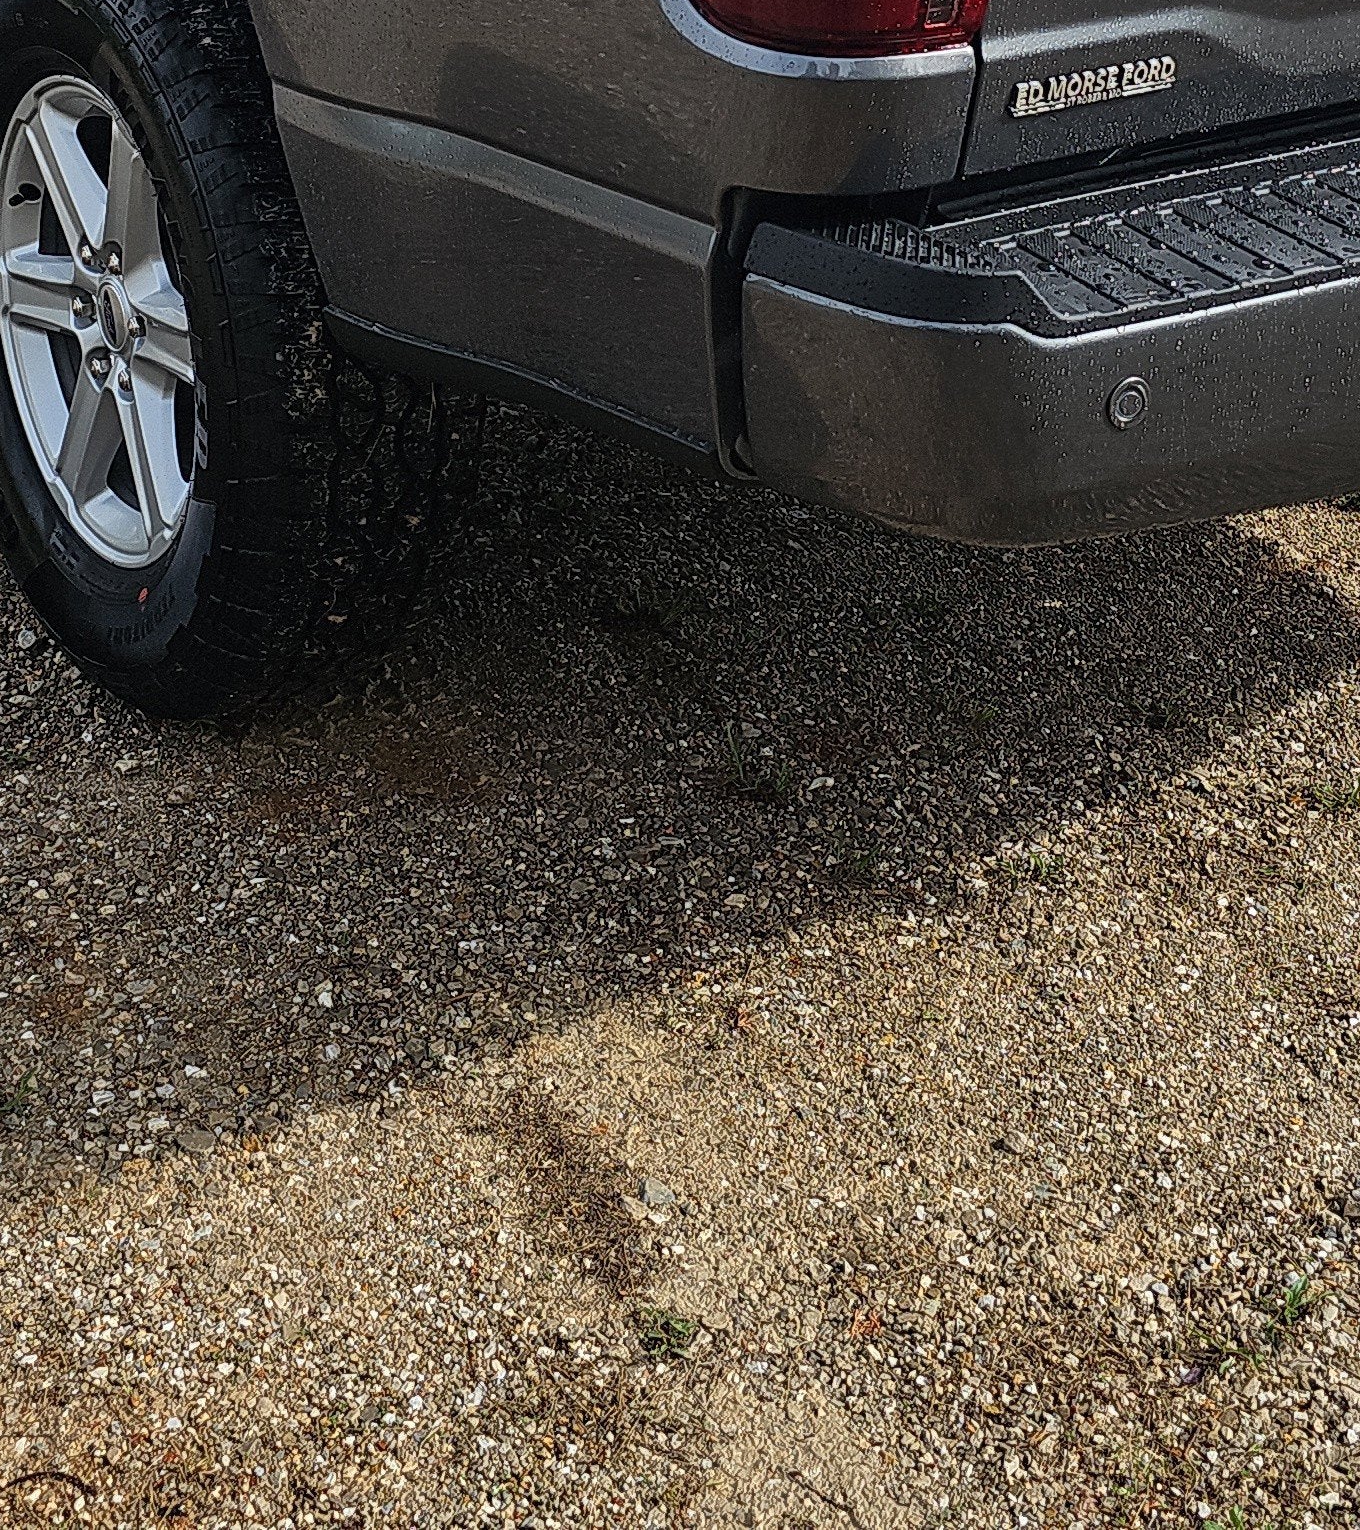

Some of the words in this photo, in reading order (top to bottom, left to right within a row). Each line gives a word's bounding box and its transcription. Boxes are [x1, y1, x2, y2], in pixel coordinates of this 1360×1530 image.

[1015, 80, 1044, 110] ED
[1048, 65, 1120, 101] MORSE
[1122, 55, 1177, 87] FORD
